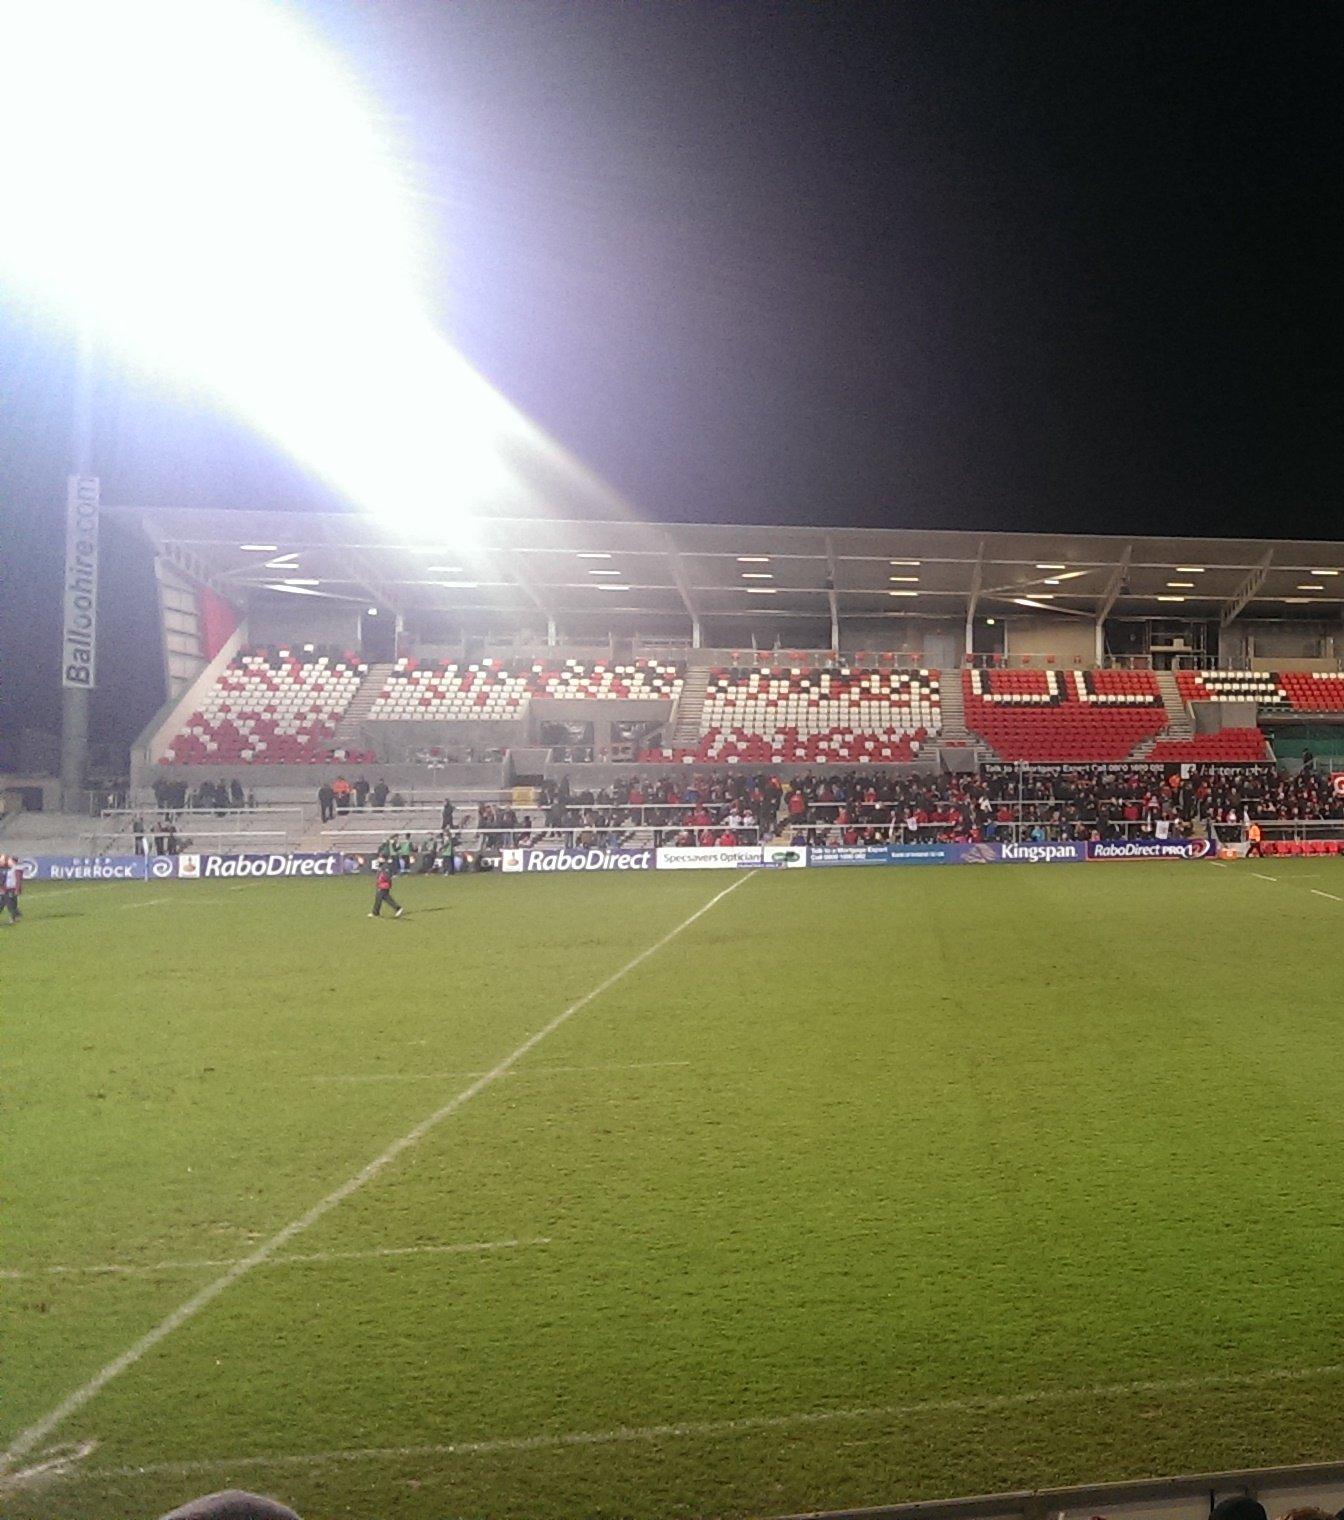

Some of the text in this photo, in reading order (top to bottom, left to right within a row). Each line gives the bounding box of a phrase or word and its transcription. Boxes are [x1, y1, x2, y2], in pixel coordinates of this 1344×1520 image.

[720, 853, 764, 862] Optician
[1001, 843, 1077, 863] Kingspan
[1094, 843, 1160, 856] RaboDirect
[205, 854, 335, 877] RaboDirect
[527, 848, 651, 871] RaboDirect
[50, 864, 133, 878] RIVERROCK
